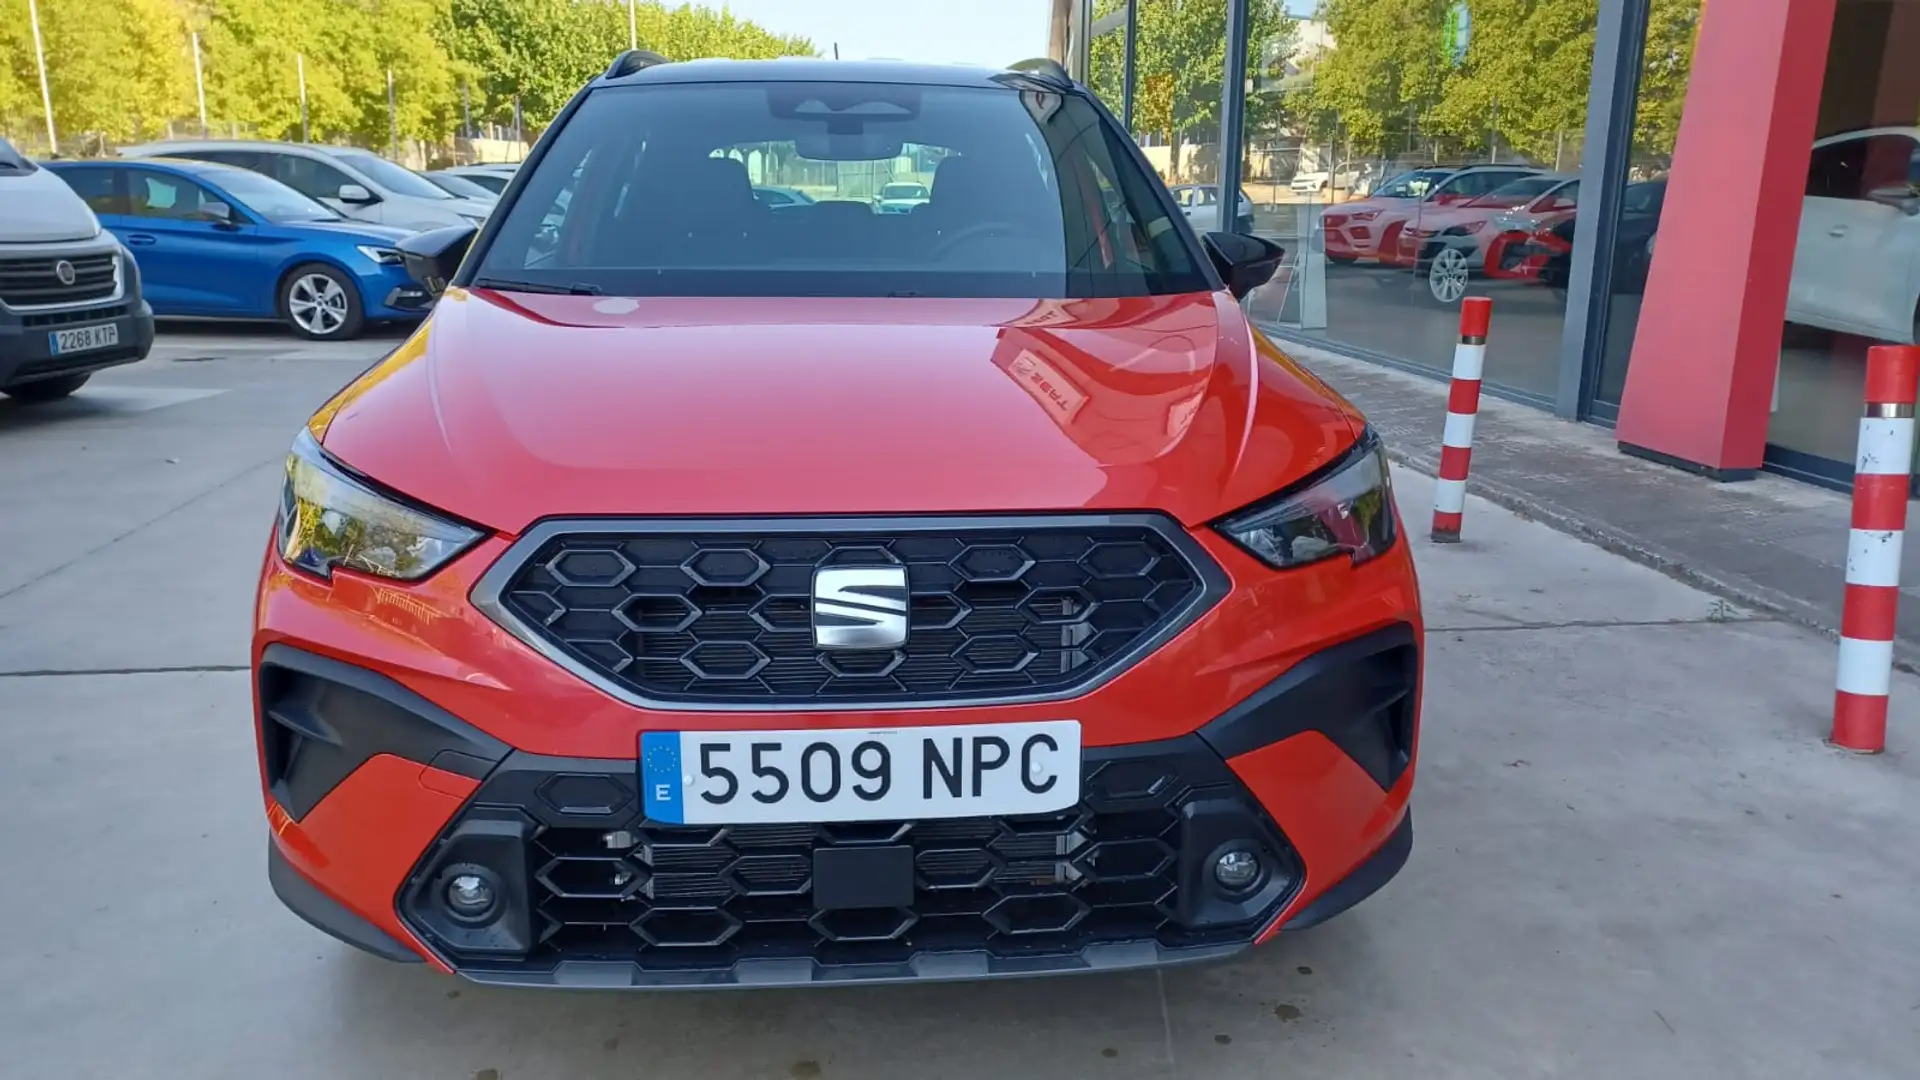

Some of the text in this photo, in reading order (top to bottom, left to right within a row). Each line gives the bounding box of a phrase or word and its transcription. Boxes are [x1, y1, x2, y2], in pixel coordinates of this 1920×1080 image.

[61, 326, 116, 351] 2268 KTP
[700, 733, 1058, 804] 5509 NPC
[656, 784, 671, 801] E
